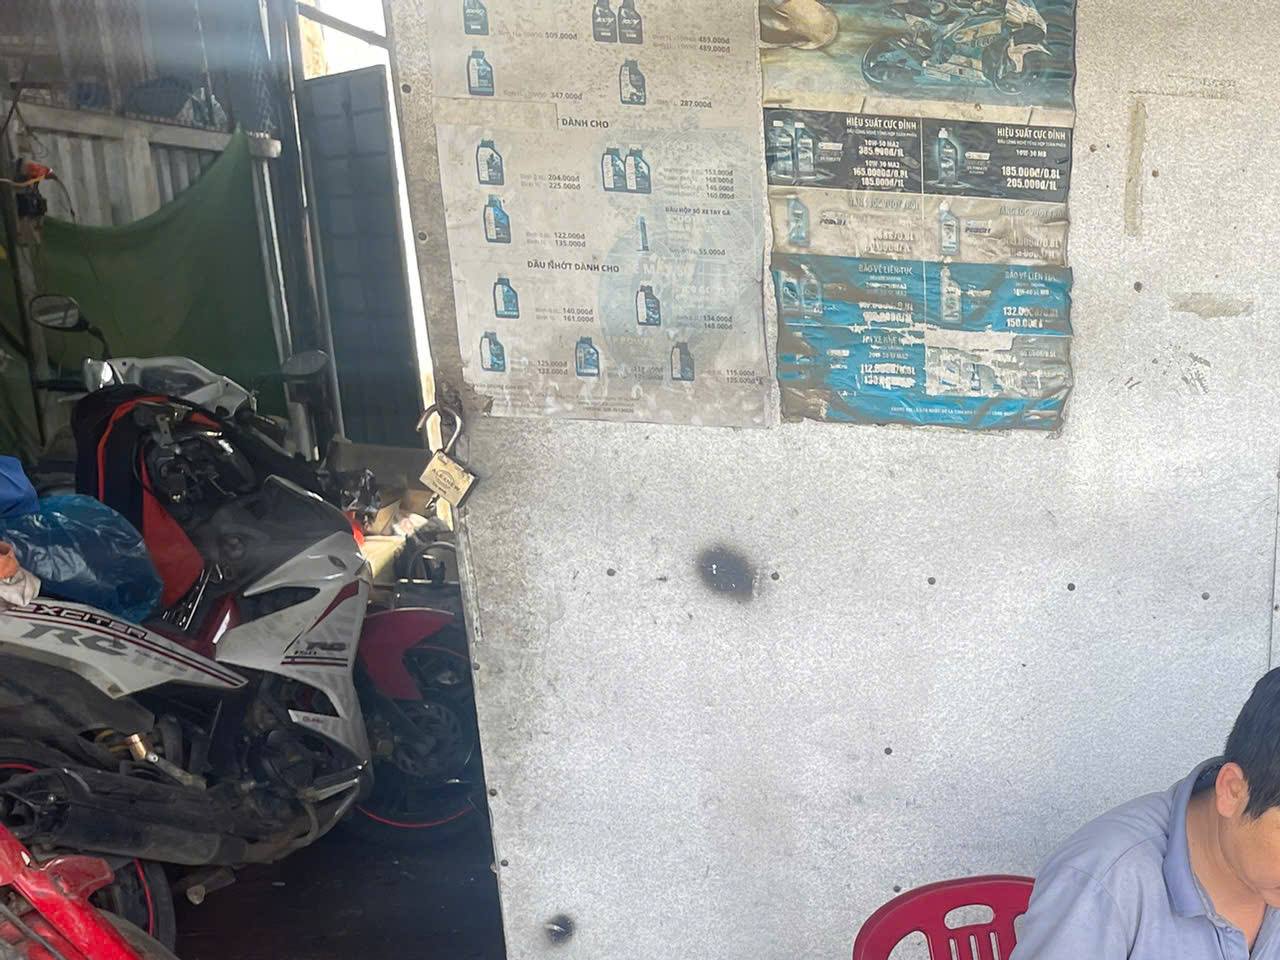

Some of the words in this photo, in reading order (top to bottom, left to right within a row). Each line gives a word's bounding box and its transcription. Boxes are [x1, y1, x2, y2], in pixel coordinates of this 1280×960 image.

[561, 116, 588, 128] DÀNH
[589, 119, 609, 129] CHO
[846, 117, 864, 128] HIỆU
[997, 127, 1014, 138] HIỆU
[527, 258, 546, 271] DẦU
[574, 260, 599, 273] DÀNH
[600, 263, 620, 274] CHO
